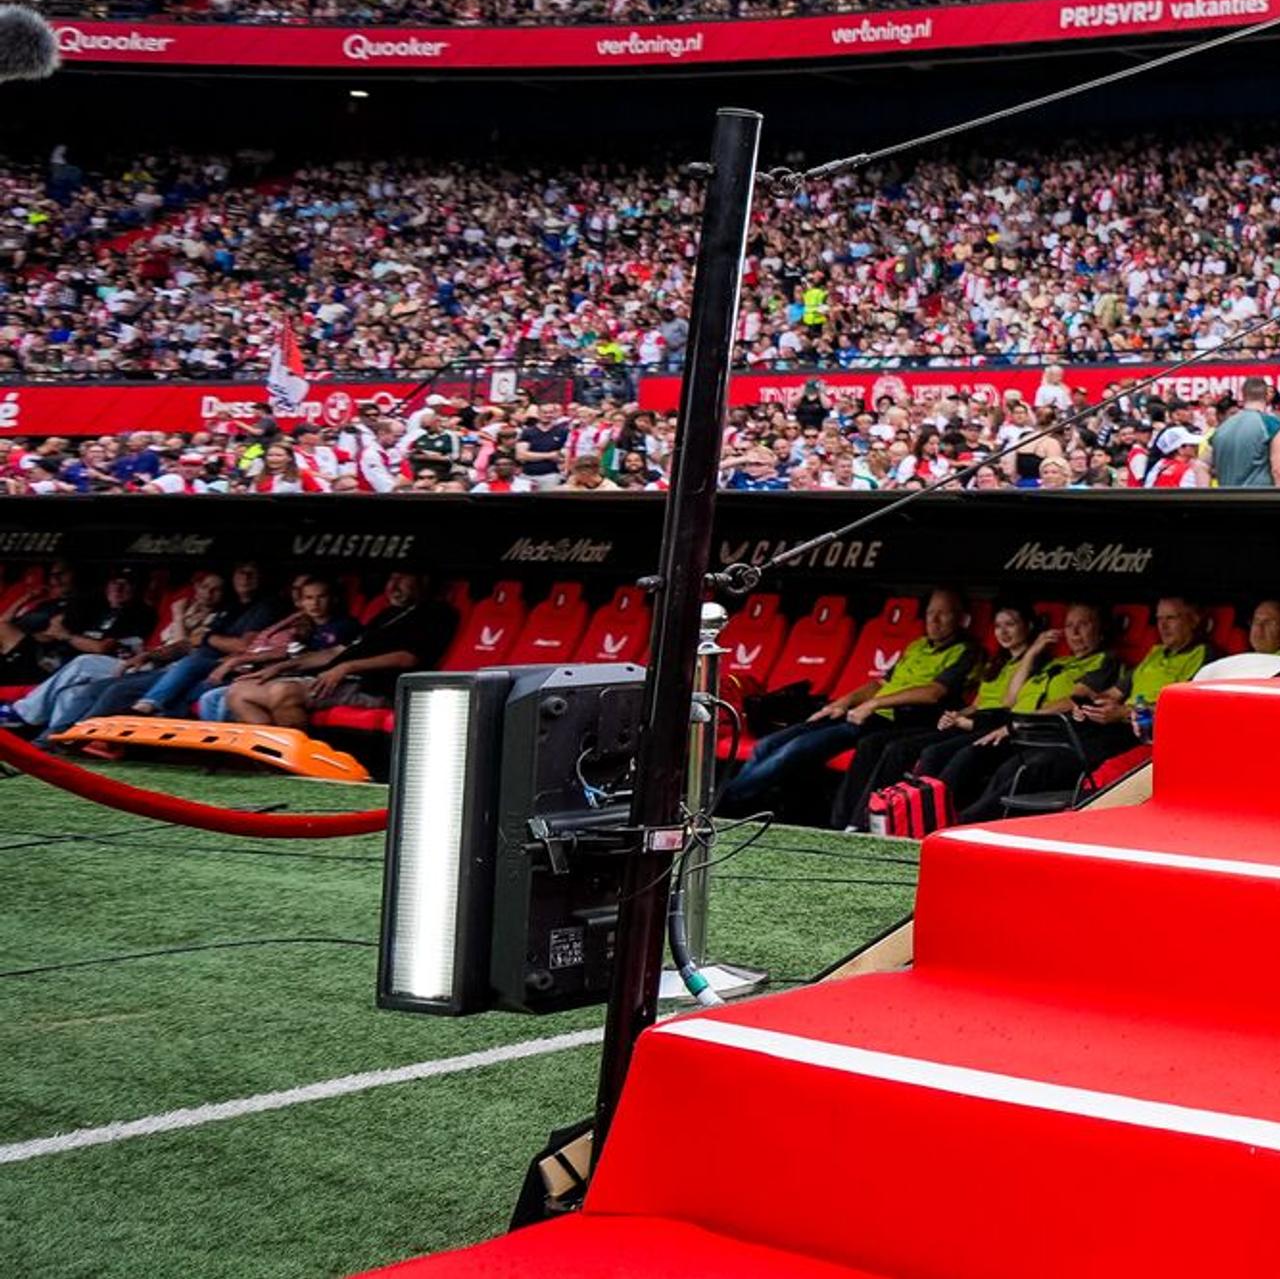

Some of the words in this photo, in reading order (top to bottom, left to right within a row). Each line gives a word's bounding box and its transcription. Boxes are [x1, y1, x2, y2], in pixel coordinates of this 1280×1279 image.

[55, 27, 175, 53] Quooker
[831, 18, 932, 44] verloning.nl
[343, 34, 449, 60] Quooker
[597, 32, 703, 58] verloning.nl
[316, 534, 415, 559] CASTORE
[1004, 541, 1073, 570] Media
[1090, 543, 1153, 574] Markt
